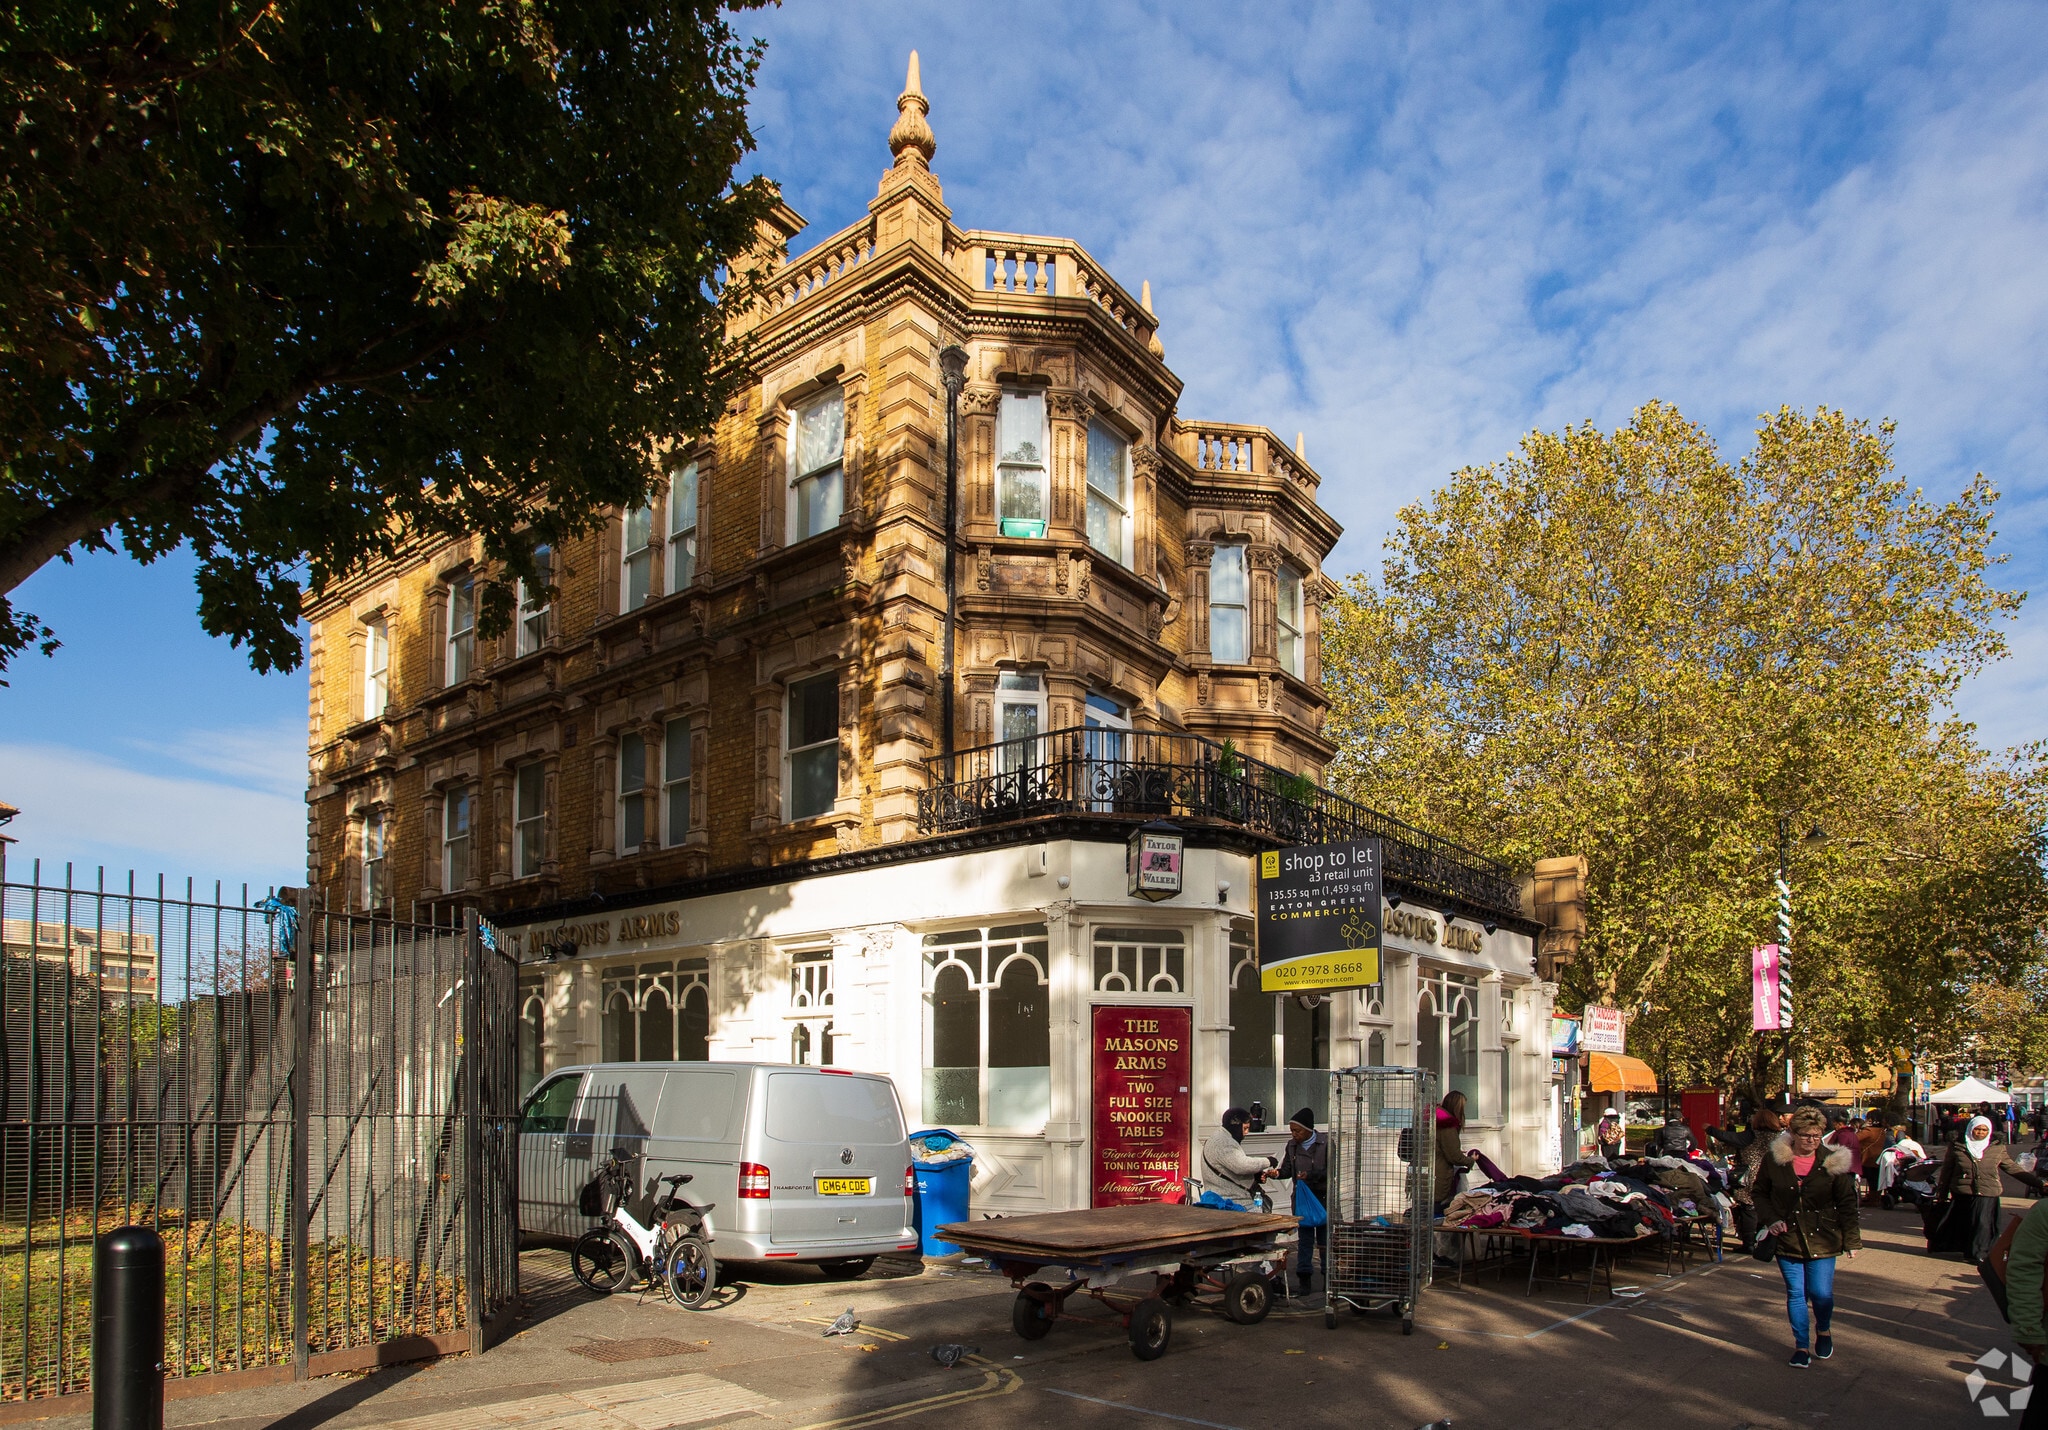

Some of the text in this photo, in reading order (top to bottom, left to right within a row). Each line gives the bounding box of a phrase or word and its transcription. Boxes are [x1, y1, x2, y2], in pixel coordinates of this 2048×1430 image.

[1147, 839, 1176, 850] TAYLOR
[1285, 847, 1373, 871] shop to let
[1144, 873, 1176, 884] WALKER
[1309, 867, 1373, 882] a3 retail unit
[1269, 889, 1297, 900] 135.55
[1312, 888, 1320, 896] m
[1322, 884, 1349, 896] (1,459
[1351, 884, 1361, 893] sq
[1364, 881, 1374, 892] ft)
[1270, 896, 1365, 910] EATON GREEN
[1271, 906, 1365, 920] COMMERCIAL
[528, 920, 610, 954] MASONS
[617, 910, 680, 942] ARMS
[1382, 907, 1483, 955] ASONS ARMS
[1275, 962, 1363, 977] 020 7978 8668
[1284, 976, 1354, 986] www.eatongreen.com
[1124, 1019, 1159, 1033] THE
[1104, 1038, 1179, 1052] MASONS
[1114, 1057, 1167, 1070] ARMS
[1127, 1082, 1155, 1093] TWO
[1109, 1097, 1173, 1108] FULL SIZE
[1110, 1111, 1172, 1123] SNOOKER
[1118, 1126, 1164, 1137] TABLES
[1102, 1148, 1180, 1161] Figure Shapers
[1103, 1161, 1179, 1170] TONING TABLES
[822, 1181, 866, 1191] GM64 CDE
[1098, 1181, 1182, 1194] Morning Coffee
